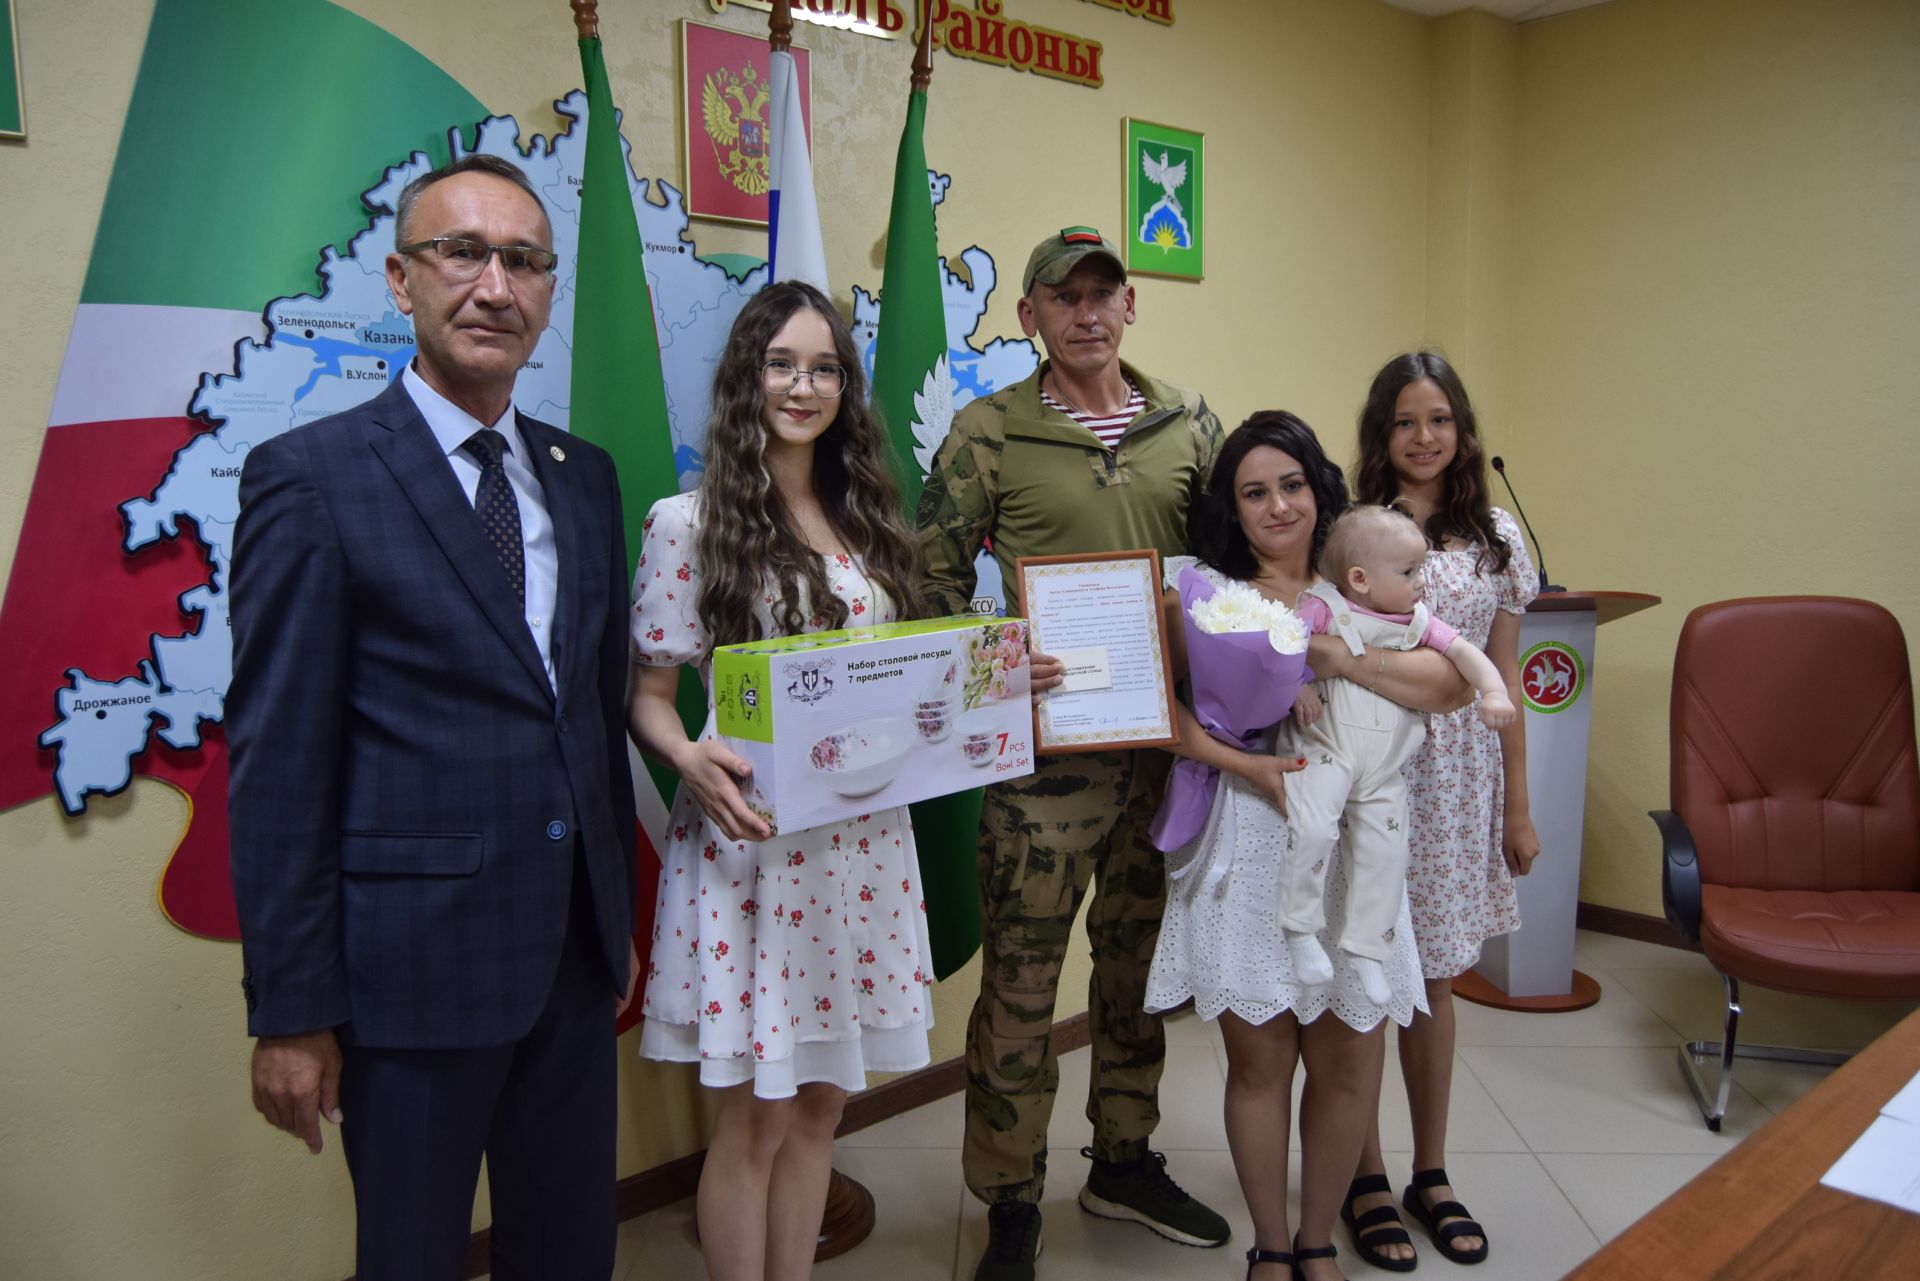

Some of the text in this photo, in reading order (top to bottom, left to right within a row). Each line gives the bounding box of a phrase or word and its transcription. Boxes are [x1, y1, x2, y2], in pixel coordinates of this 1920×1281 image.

[645, 241, 677, 255] Кукмор
[277, 315, 357, 330] Зеленодольск
[363, 329, 414, 345] Казань
[346, 369, 387, 381] В.Услон
[847, 649, 952, 672] Набор столовой посуды
[847, 668, 904, 684] 7 предметов
[72, 694, 152, 713] Дрожжаное
[996, 732, 1009, 756] 7
[995, 756, 1029, 772] Bowl Set
